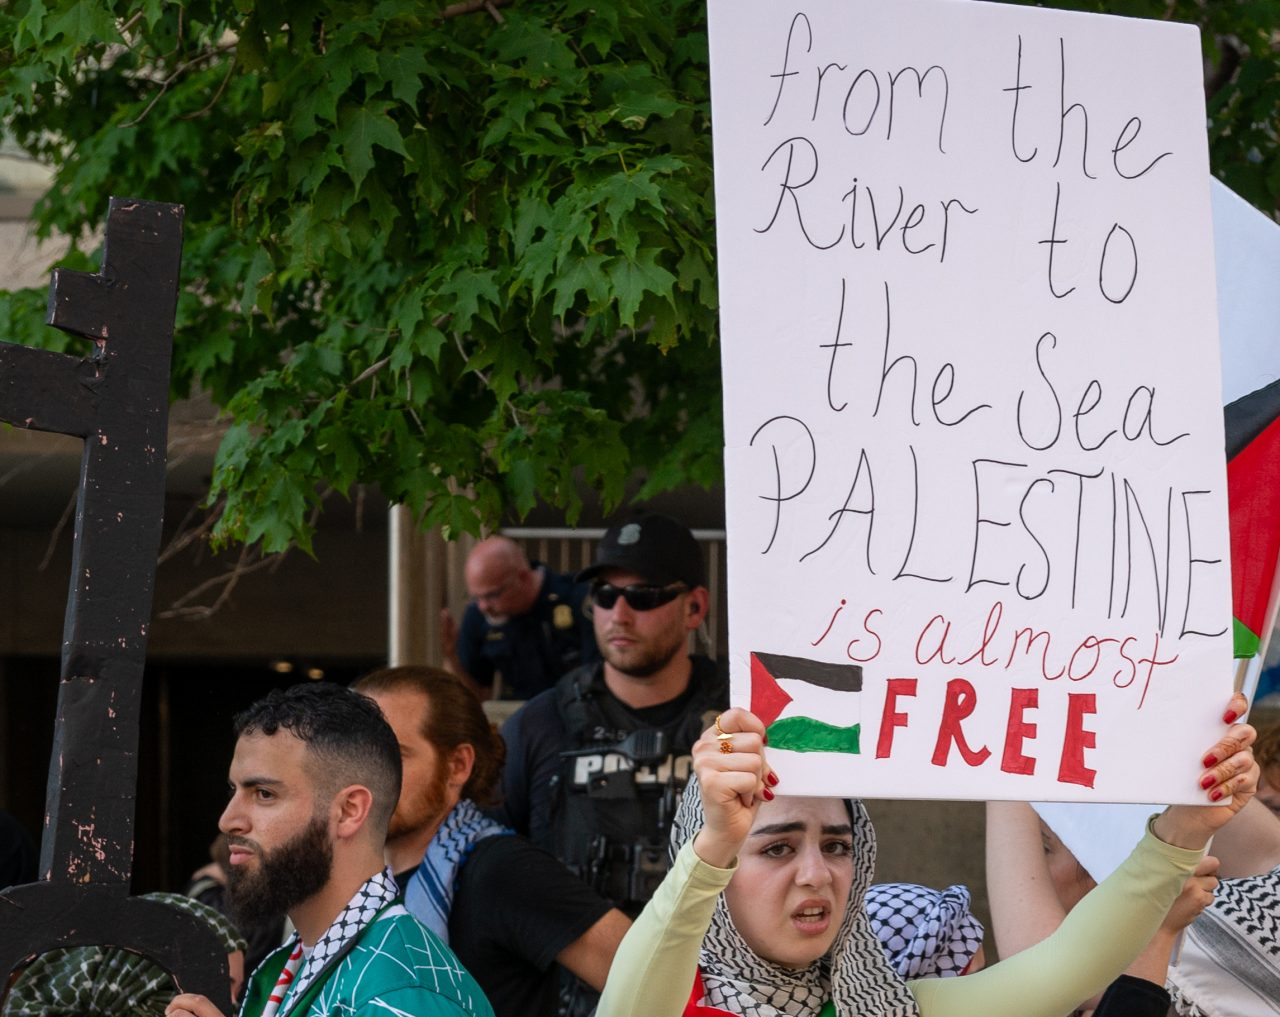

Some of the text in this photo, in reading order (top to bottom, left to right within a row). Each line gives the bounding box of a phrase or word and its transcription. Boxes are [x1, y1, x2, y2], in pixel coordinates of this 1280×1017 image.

[764, 12, 1173, 180] from the
[753, 136, 1138, 304] River to
[819, 278, 1190, 451] the Sea
[750, 415, 1228, 640] PALESTINE
[812, 598, 1178, 709] is almost
[874, 678, 1097, 789] FREE
